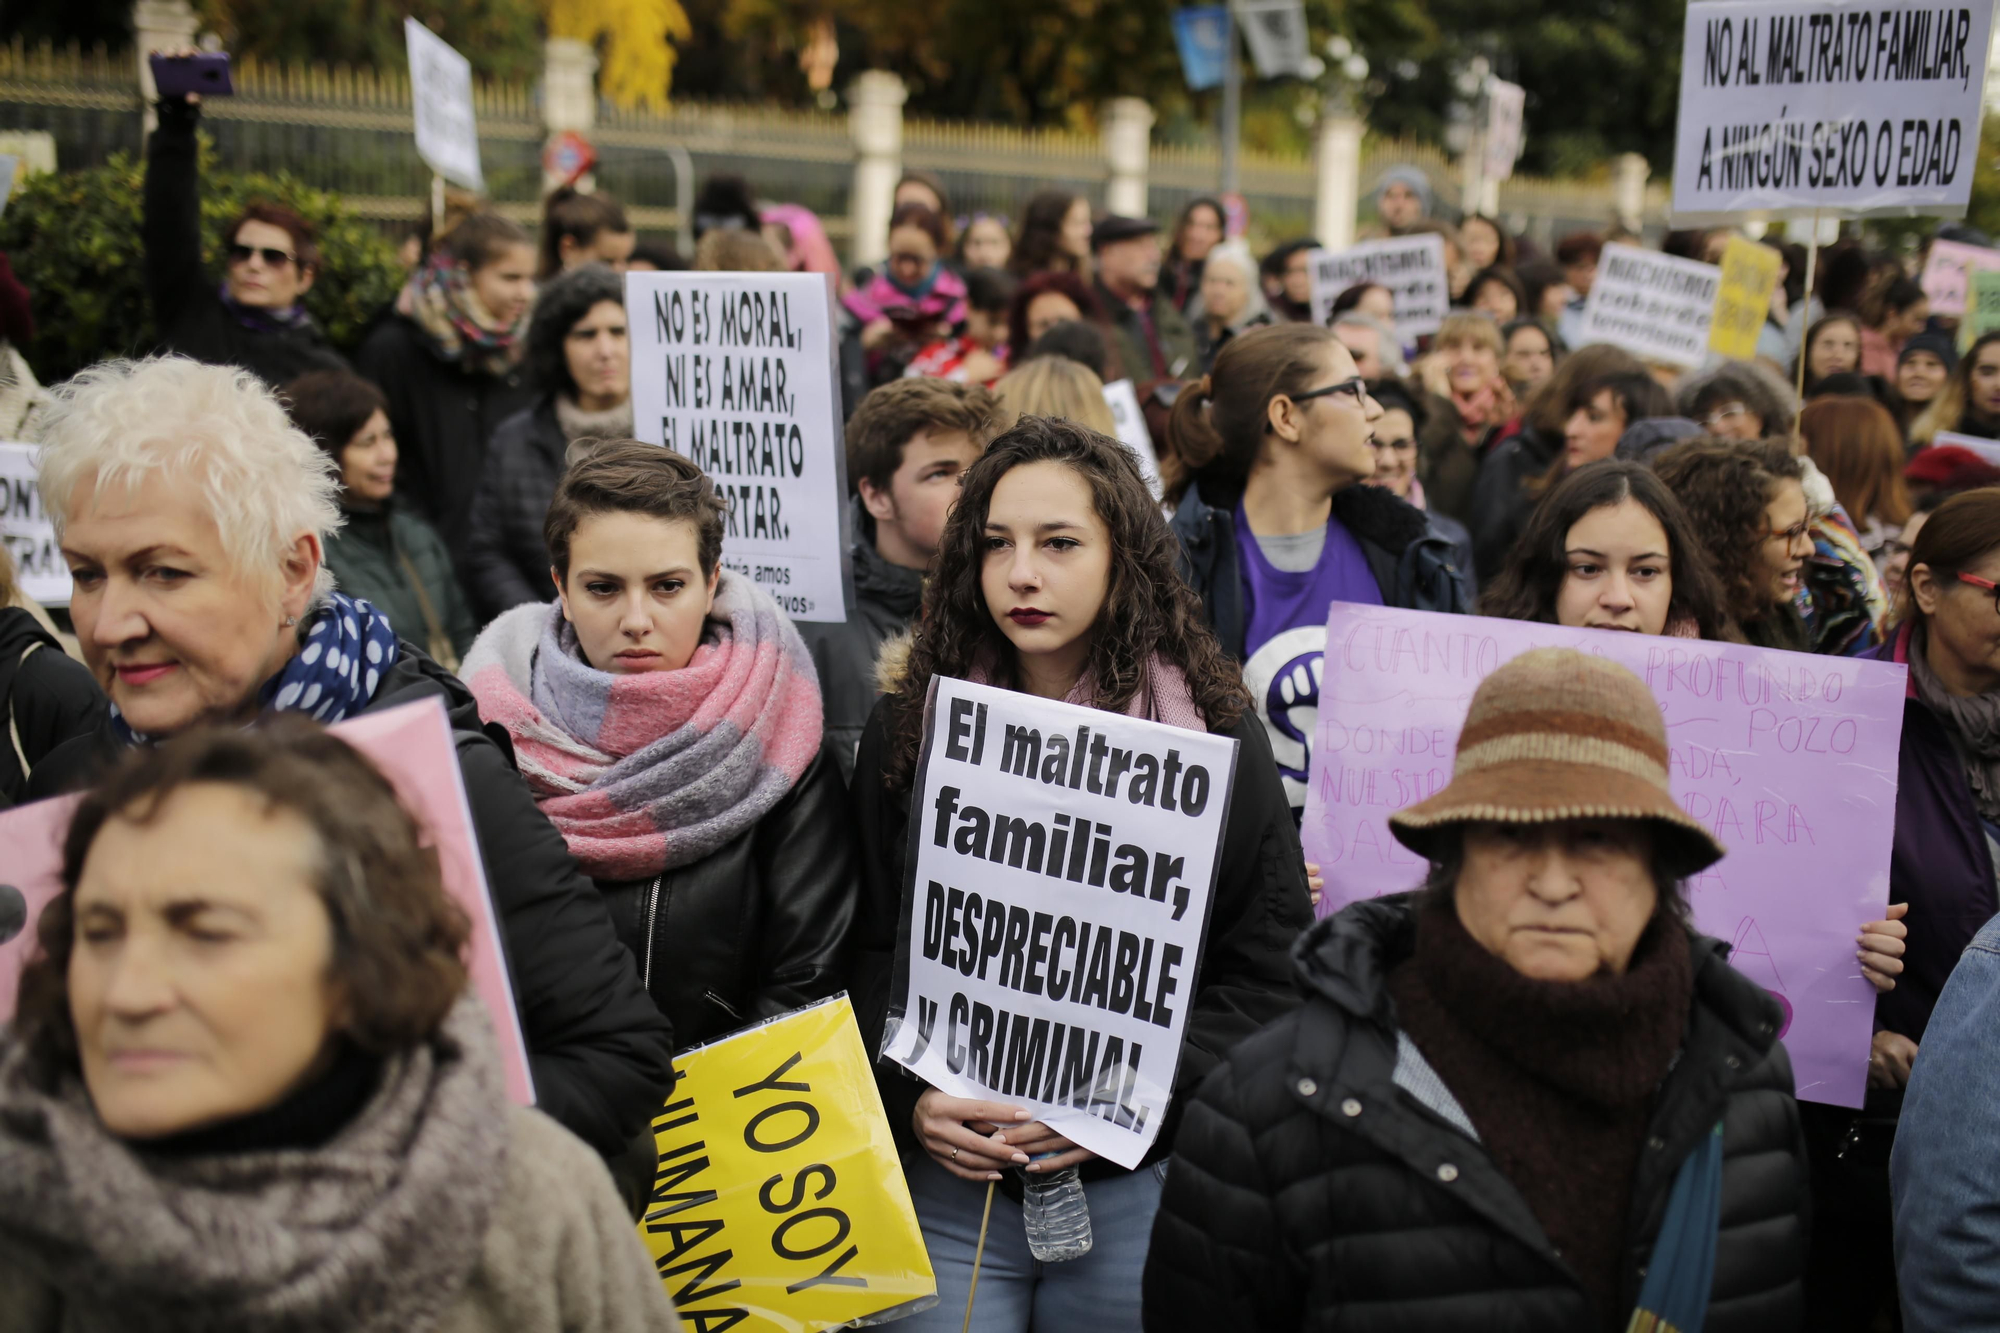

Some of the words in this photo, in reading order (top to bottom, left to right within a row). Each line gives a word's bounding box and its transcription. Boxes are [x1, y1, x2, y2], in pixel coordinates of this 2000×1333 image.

[1703, 17, 1733, 87] NO
[1735, 17, 1760, 86] AL
[1766, 11, 1872, 85] MALTRATO
[1873, 8, 1971, 92] FAMILIAR,
[1697, 126, 1712, 191] A
[1720, 104, 1804, 191] NINGÚN
[1808, 120, 1869, 188] SEXO
[1874, 119, 1893, 188] O
[1896, 118, 1962, 187] EDAD
[654, 289, 684, 344] NO
[692, 290, 710, 345] ES
[719, 291, 802, 352] MORAL,
[666, 354, 686, 408] NI
[694, 354, 711, 409] ES
[721, 355, 795, 417] AMAR,
[691, 418, 803, 478] MALTRATO
[755, 565, 790, 584] amos
[1344, 623, 1498, 678] CUANTO
[1646, 645, 1843, 706] PROFUNDO
[945, 696, 988, 766] El
[999, 724, 1210, 818] maltrato
[1326, 719, 1447, 759] DONDE
[1749, 707, 1857, 754] POZO
[933, 785, 1191, 922] familiar,
[922, 879, 1184, 1030] DESPRECIABLE
[732, 1050, 821, 1154] YO
[901, 994, 938, 1066] y
[946, 992, 1151, 1135] CRIMINAL.
[758, 1163, 869, 1295] SOY
